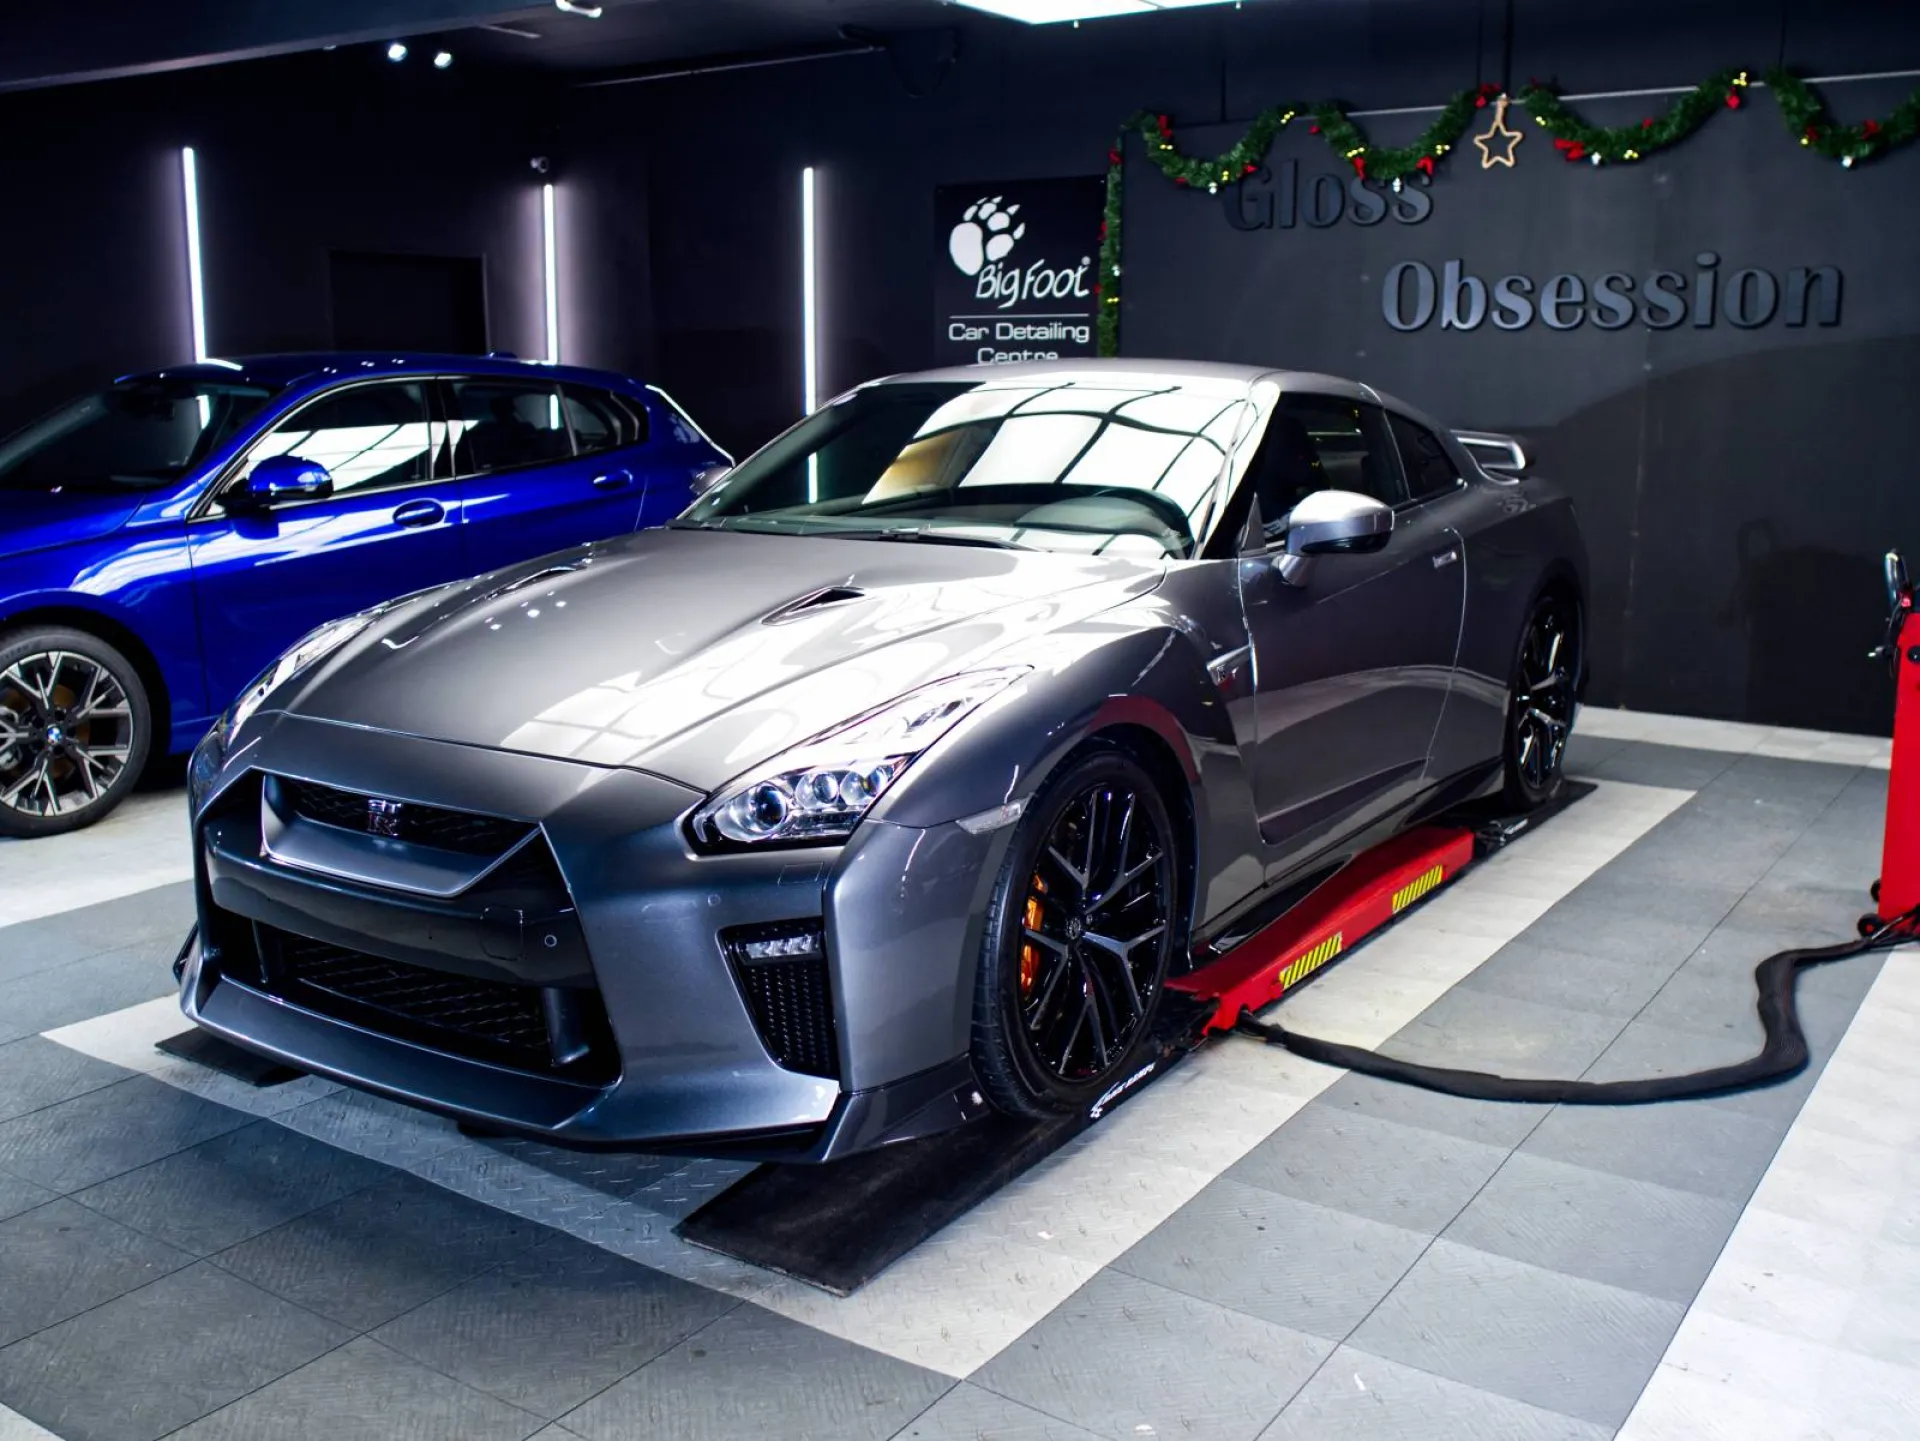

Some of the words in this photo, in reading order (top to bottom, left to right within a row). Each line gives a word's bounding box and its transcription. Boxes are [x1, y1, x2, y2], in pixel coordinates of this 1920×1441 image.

[1223, 158, 1434, 232] Gloss
[1381, 251, 1844, 332] Obsession
[948, 323, 989, 341] Car
[995, 322, 1090, 344] Detailing
